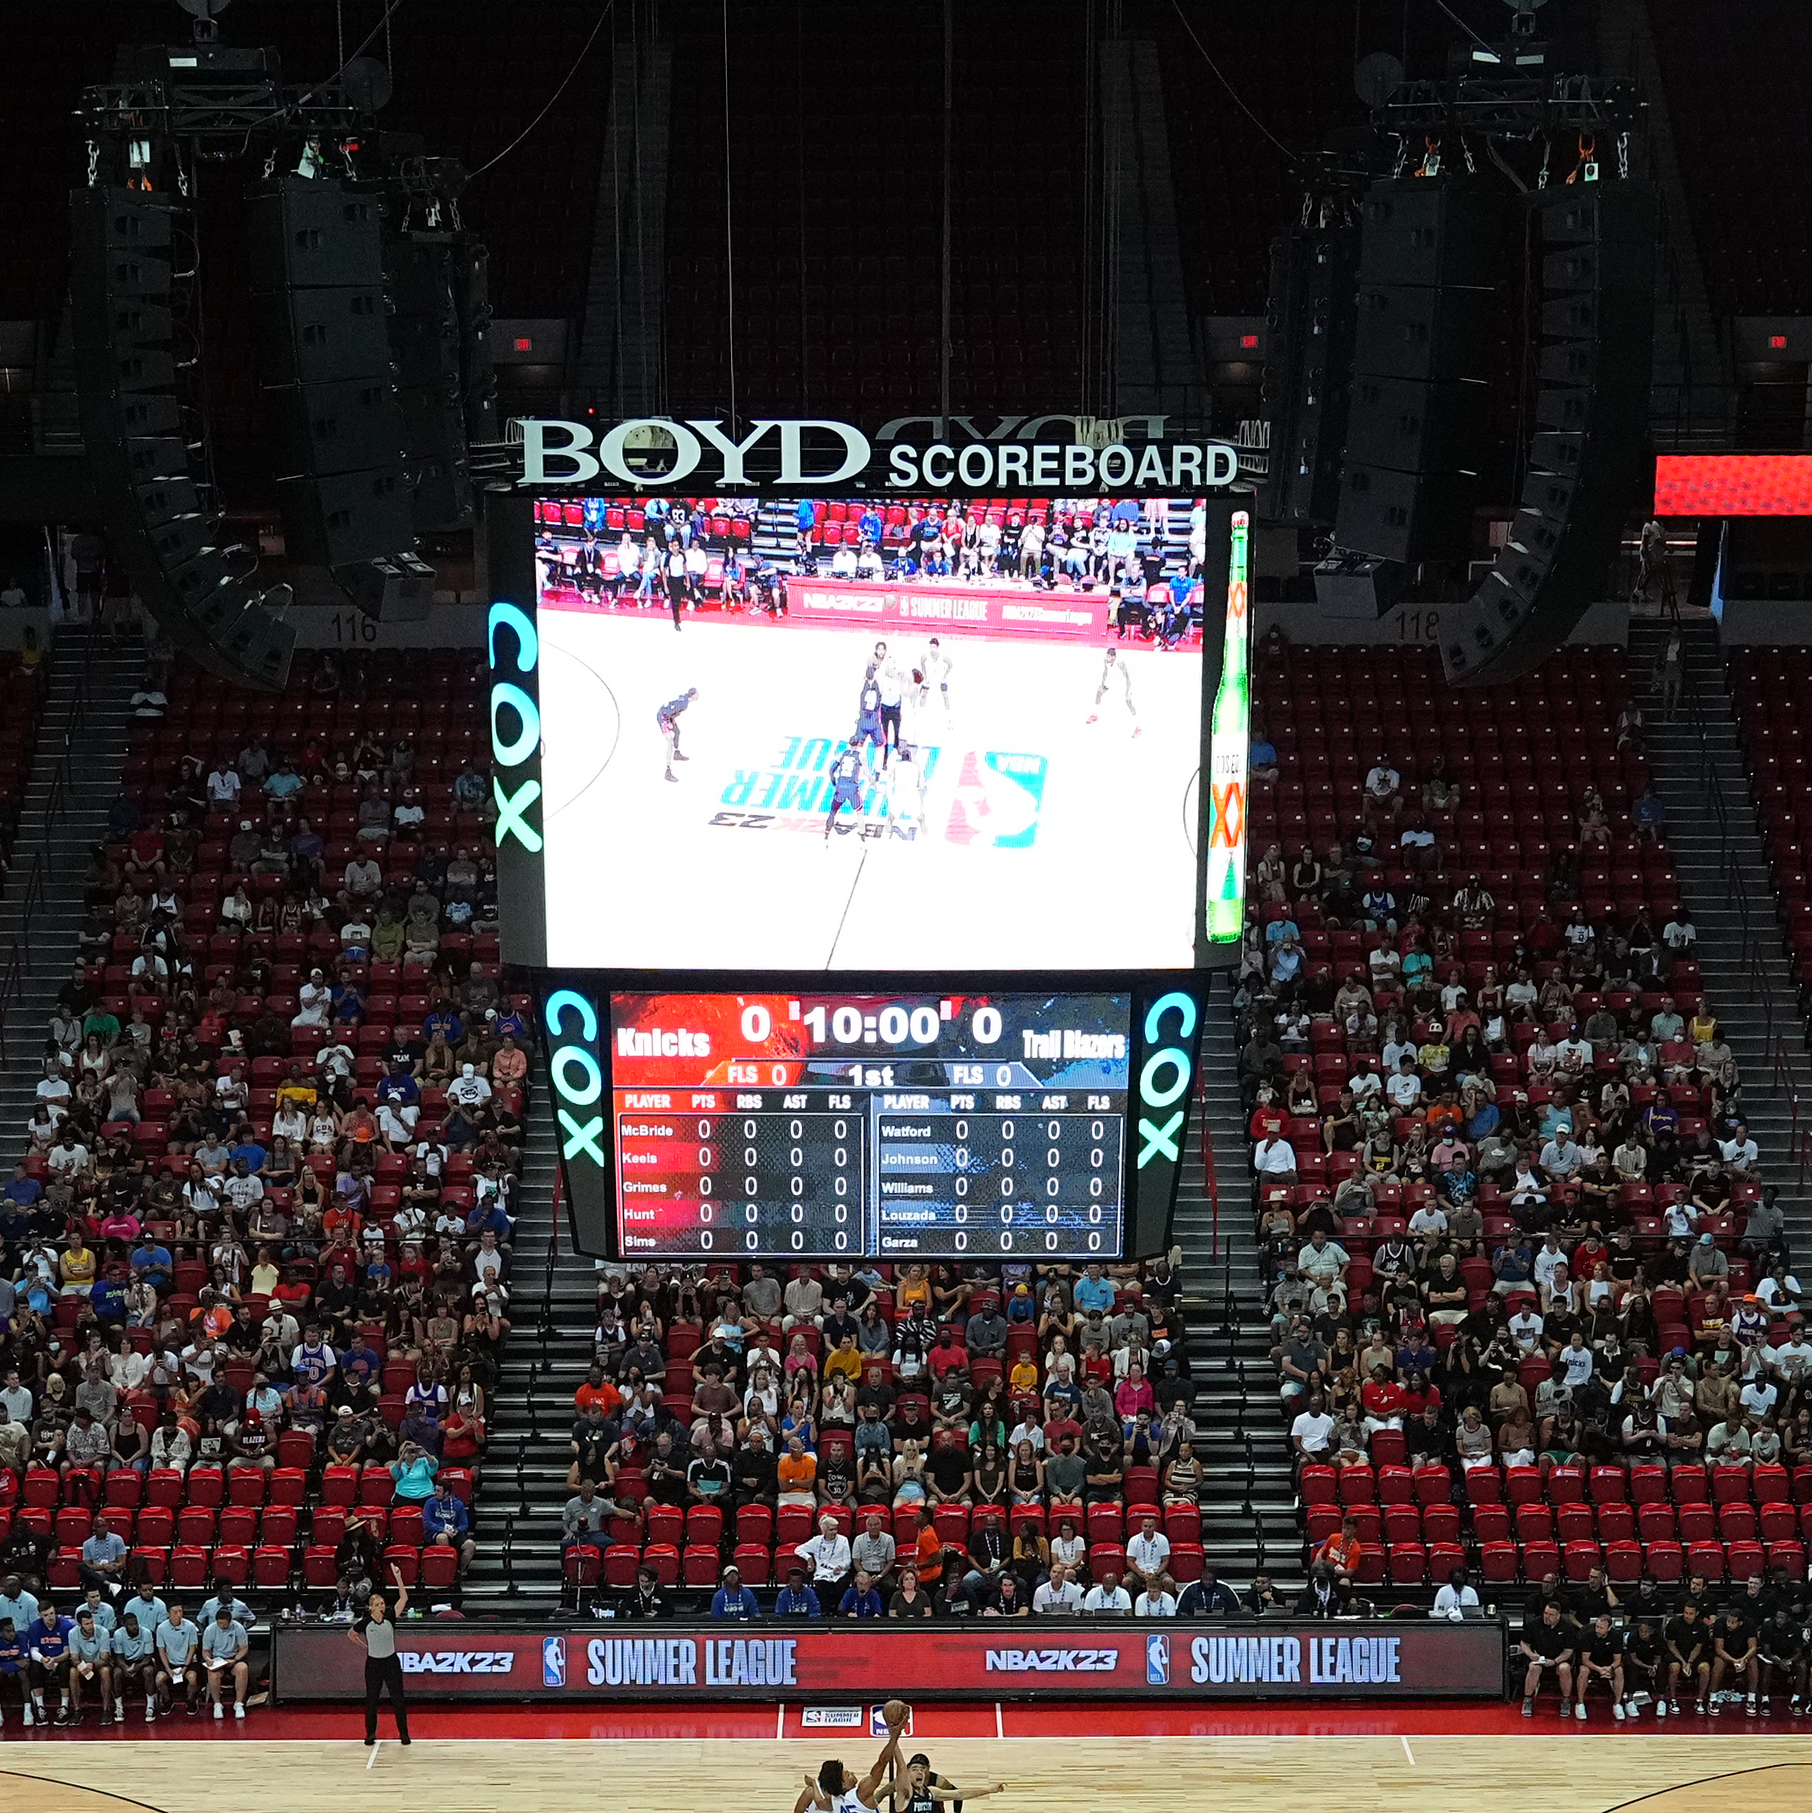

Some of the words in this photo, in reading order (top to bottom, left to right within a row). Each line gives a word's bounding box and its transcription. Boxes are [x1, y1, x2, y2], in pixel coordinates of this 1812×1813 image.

[515, 418, 871, 485] BOYD
[889, 443, 1238, 487] SCOREBOARD
[331, 612, 376, 643] 116
[488, 602, 542, 852] COX
[617, 1028, 710, 1056] Knicks
[741, 1005, 771, 1042] 0
[803, 1006, 940, 1043] 10:00
[972, 1007, 1002, 1043] 0
[1022, 1029, 1061, 1059] Trail
[1063, 1030, 1127, 1059] Blazers
[545, 990, 604, 1167] COX
[728, 1065, 758, 1083] FLS
[771, 1065, 787, 1086] 0
[848, 1065, 895, 1086] 1st
[953, 1066, 984, 1085] FLS
[996, 1065, 1012, 1086] 0
[1138, 992, 1196, 1170] COX
[625, 1094, 671, 1109] PLAYER
[691, 1094, 716, 1109] PTS
[736, 1094, 762, 1109] RBS
[783, 1094, 808, 1109] AST
[828, 1094, 851, 1109] FLS
[883, 1095, 929, 1110] PLAYER
[950, 1095, 975, 1110] PTS
[996, 1095, 1021, 1110] RBS
[1042, 1095, 1067, 1110] AST
[1087, 1095, 1110, 1110] FLS
[621, 1125, 673, 1137] McBride
[698, 1120, 711, 1139] 0
[744, 1120, 756, 1139] 0
[790, 1120, 802, 1139] 0
[835, 1120, 847, 1139] 0
[881, 1126, 931, 1137] Watford
[622, 1152, 658, 1164] Keels
[881, 1153, 938, 1165] Johnson
[623, 1181, 667, 1193] Grimes
[881, 1182, 934, 1194] Williams
[624, 1209, 656, 1220] Hunt
[881, 1210, 936, 1221] Louzada
[624, 1235, 657, 1247] Sims
[881, 1237, 918, 1248] Garza
[588, 1638, 697, 1686] SUMMER
[705, 1638, 797, 1686] LEAGUE
[986, 1649, 1118, 1672] NBA2K23
[1191, 1635, 1301, 1684] SUMMER
[1310, 1636, 1402, 1685] LEAGUE
